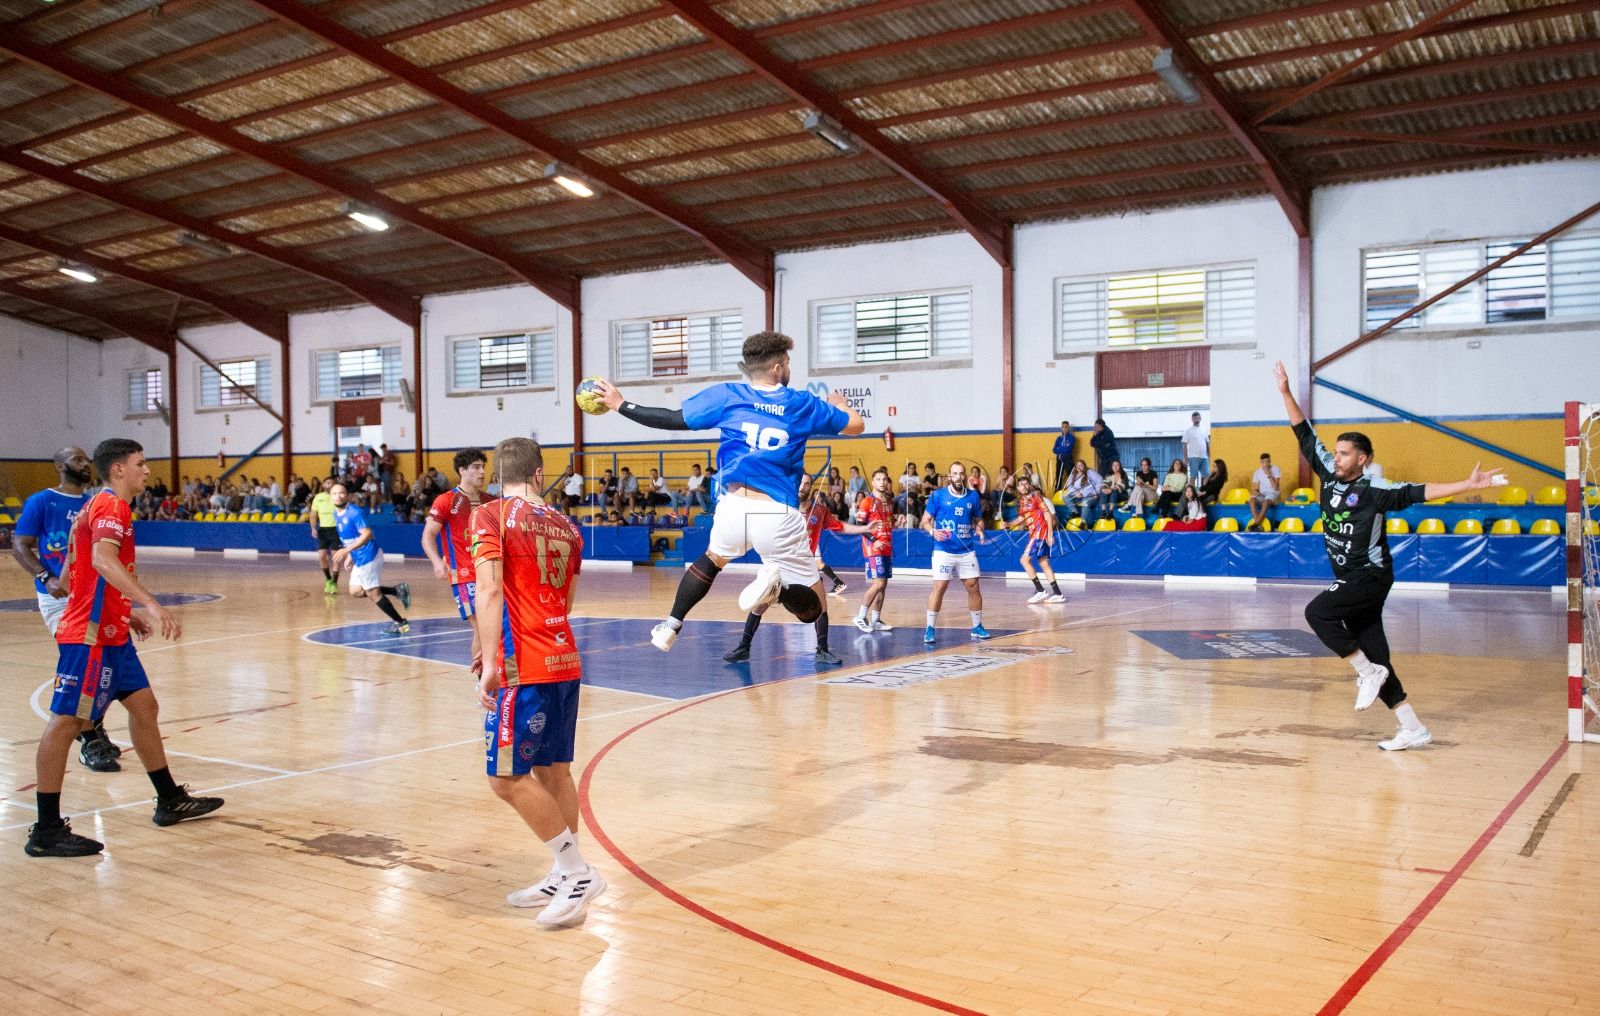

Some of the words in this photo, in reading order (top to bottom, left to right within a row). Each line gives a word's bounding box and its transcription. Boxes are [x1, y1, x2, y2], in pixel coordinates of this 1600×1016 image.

[847, 398, 864, 408] ORT
[535, 535, 571, 588] 13
[939, 565, 950, 573] 26
[544, 655, 560, 666] BM
[501, 727, 509, 742] BM
